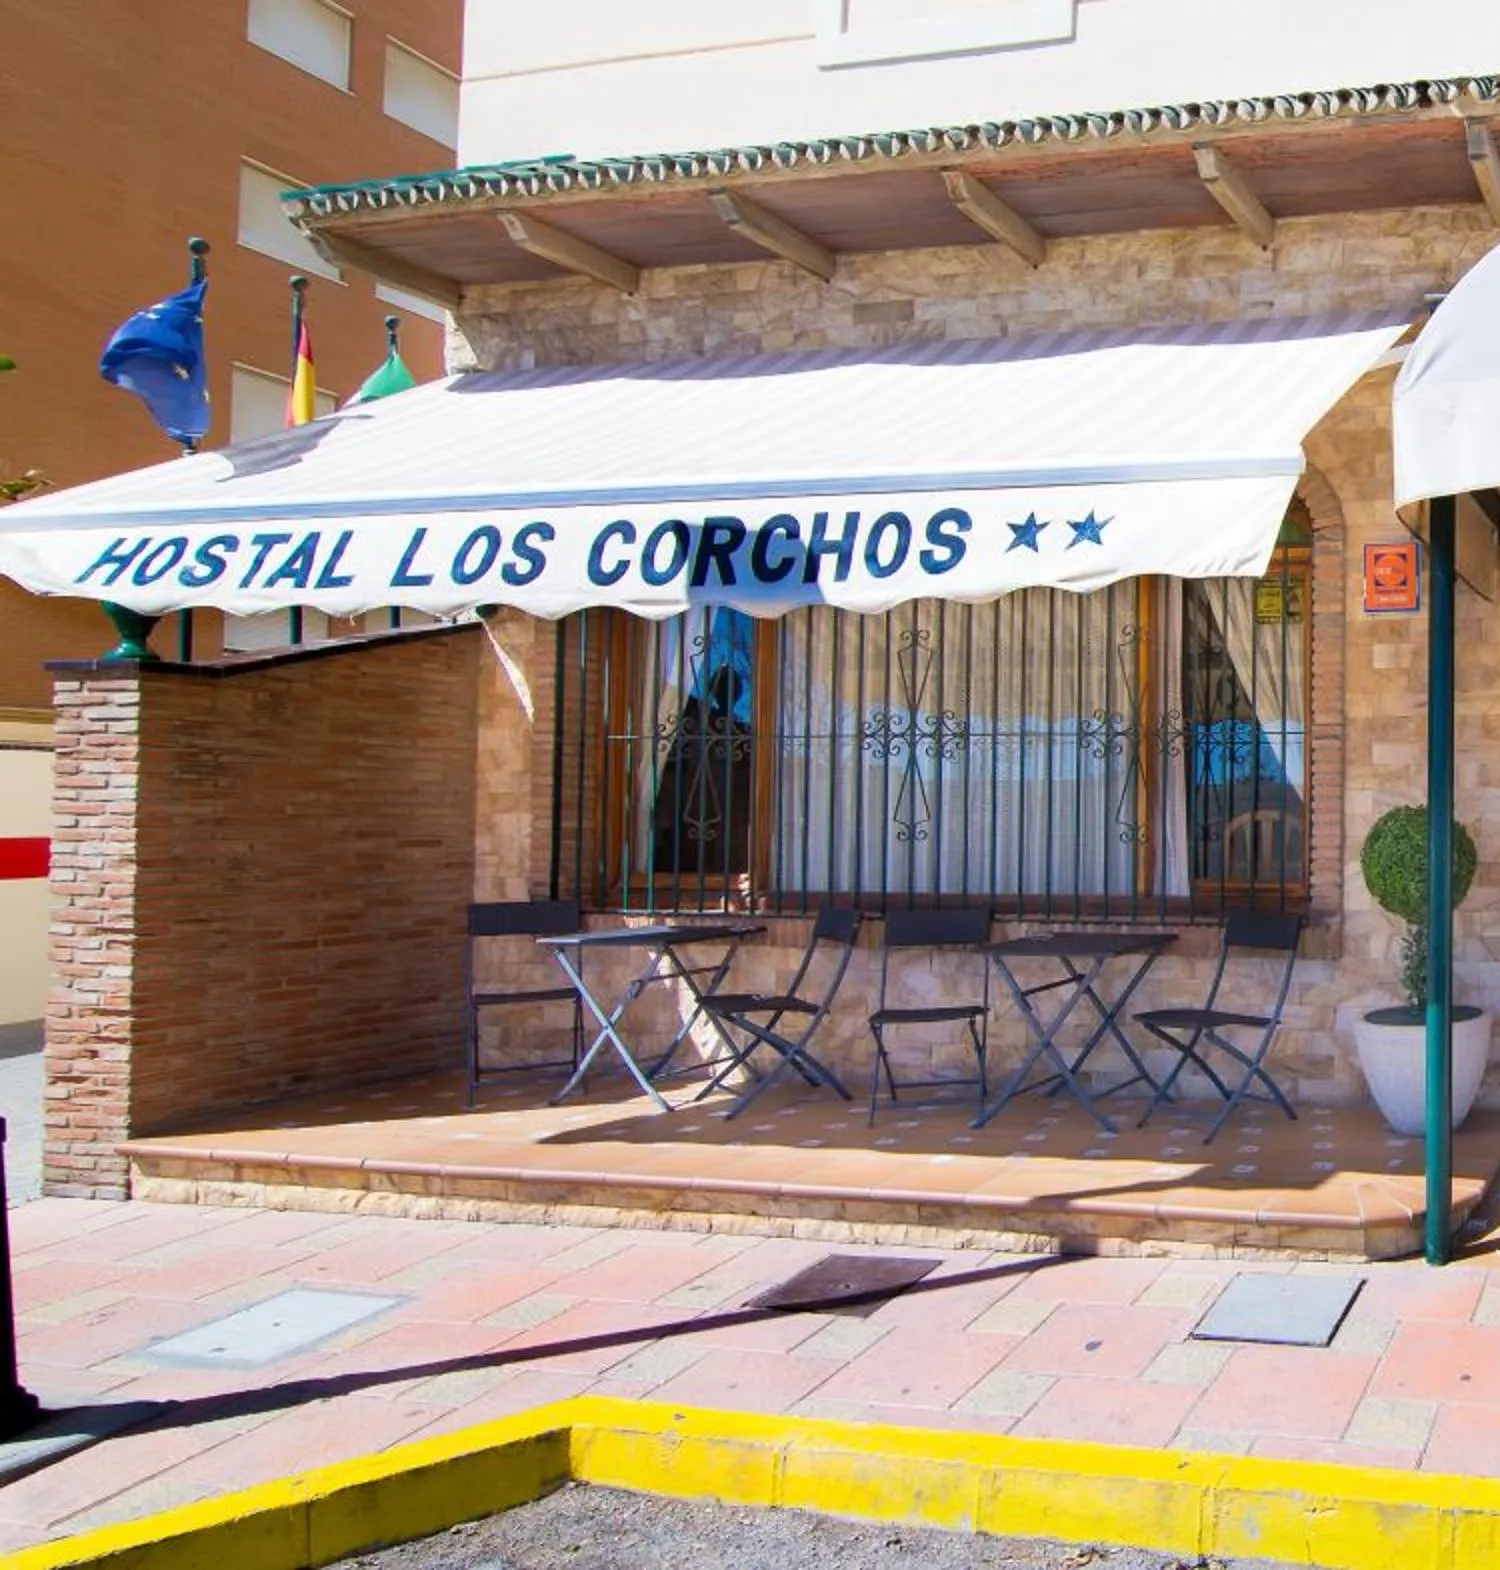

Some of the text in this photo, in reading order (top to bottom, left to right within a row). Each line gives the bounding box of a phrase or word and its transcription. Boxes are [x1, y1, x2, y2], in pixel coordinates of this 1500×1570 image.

[72, 507, 974, 590] HOSTAL LOS CORCHOS
